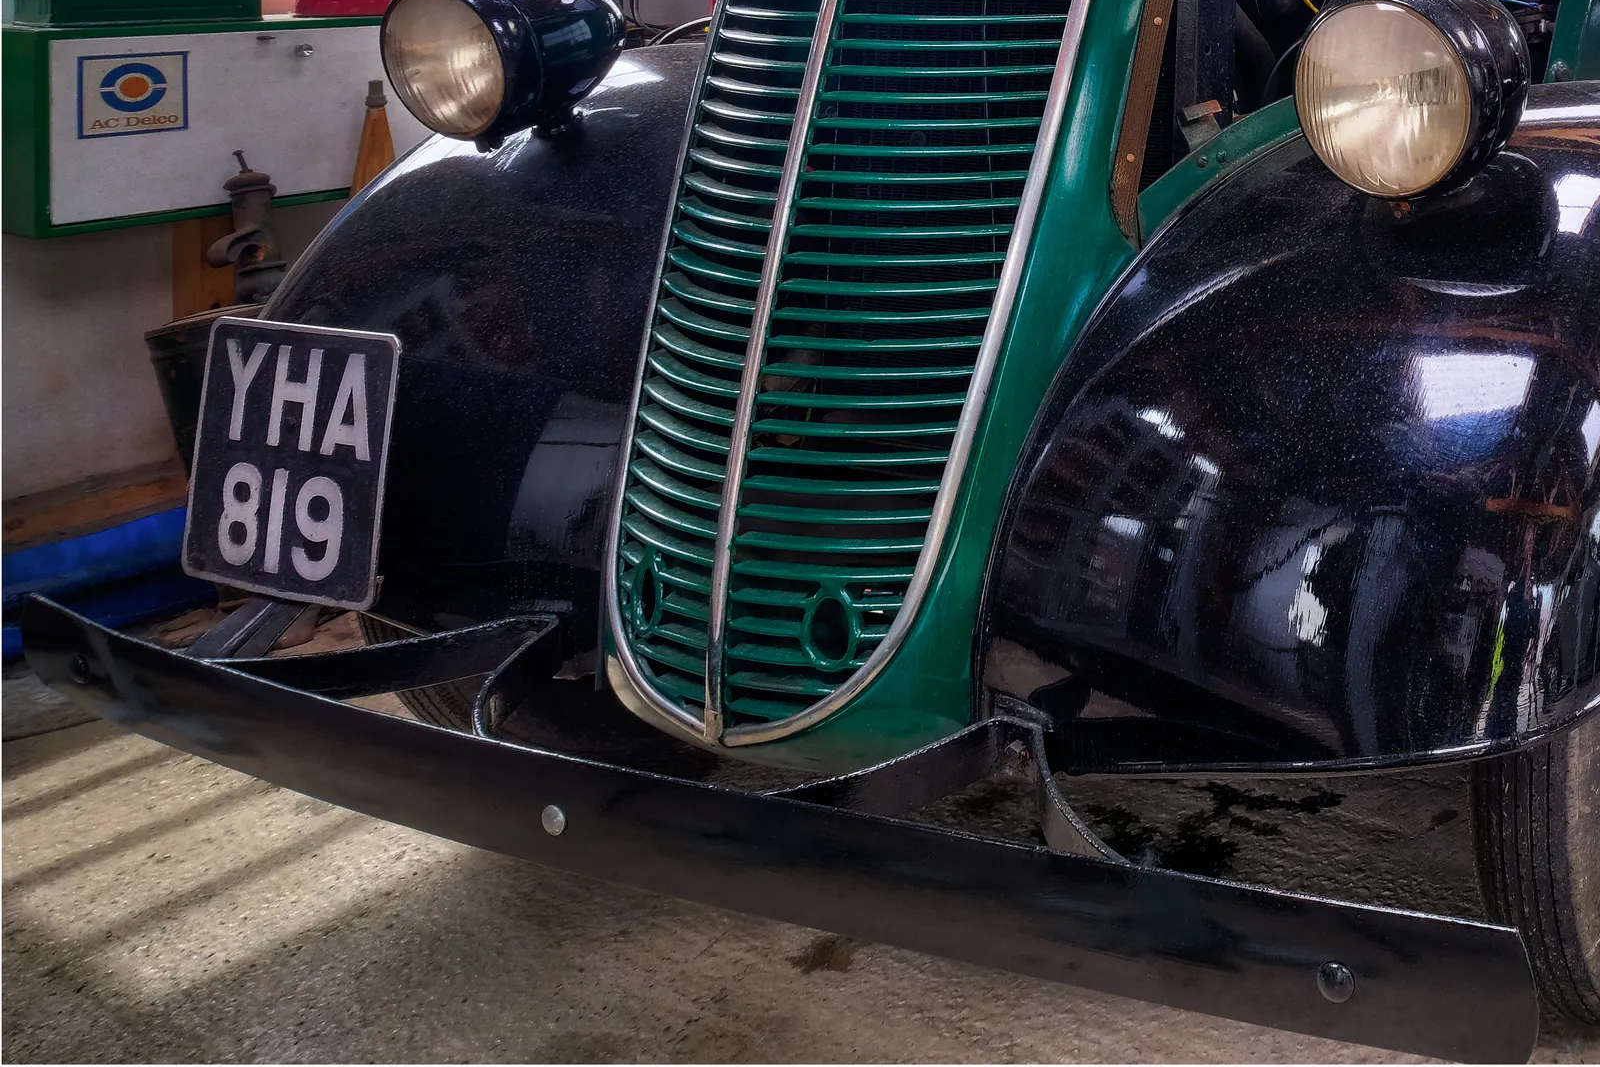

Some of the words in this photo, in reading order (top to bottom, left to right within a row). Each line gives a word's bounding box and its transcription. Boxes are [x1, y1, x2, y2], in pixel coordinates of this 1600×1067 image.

[89, 117, 119, 130] AC
[123, 114, 179, 128] Delco
[226, 337, 371, 462] YHA
[217, 462, 345, 582] 819
